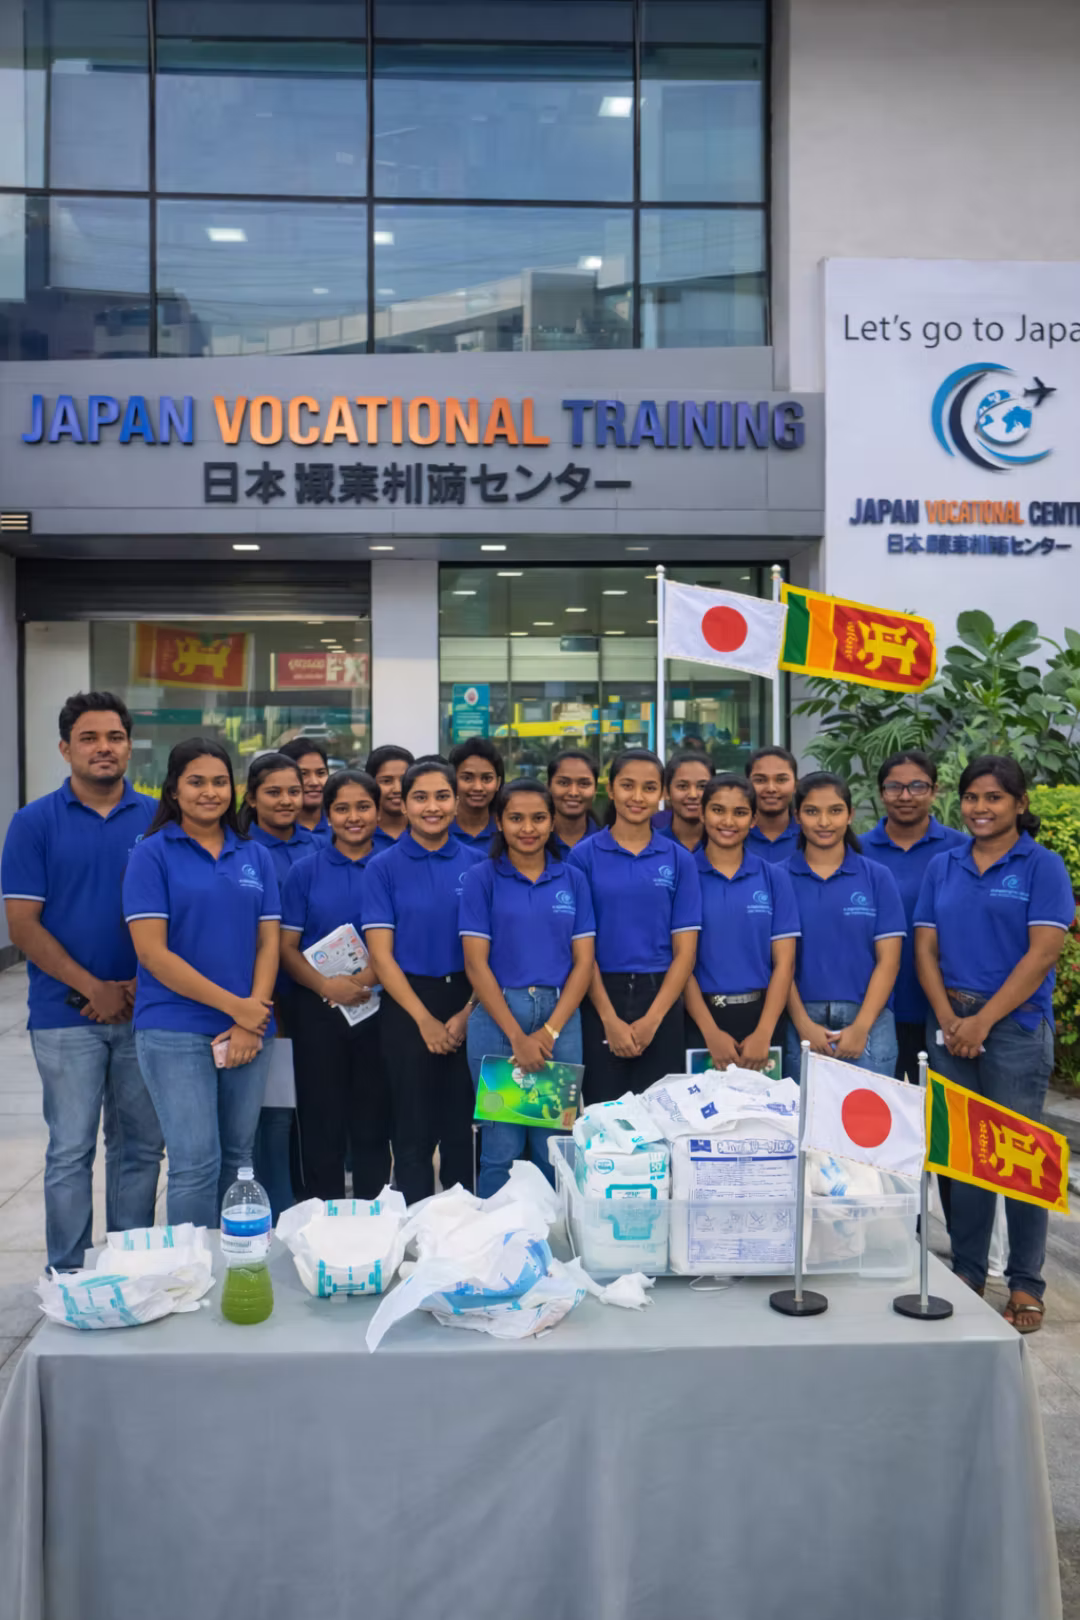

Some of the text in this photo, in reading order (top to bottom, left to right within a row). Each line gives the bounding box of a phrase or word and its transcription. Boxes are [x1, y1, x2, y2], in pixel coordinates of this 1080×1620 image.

[844, 314, 912, 341] Let's
[922, 321, 963, 349] go
[972, 317, 1004, 342] to
[21, 394, 805, 450] JAPAN VOCATIONAL TRAINING
[849, 498, 920, 525] JAPAN
[924, 499, 1025, 525] VOCATIONAL
